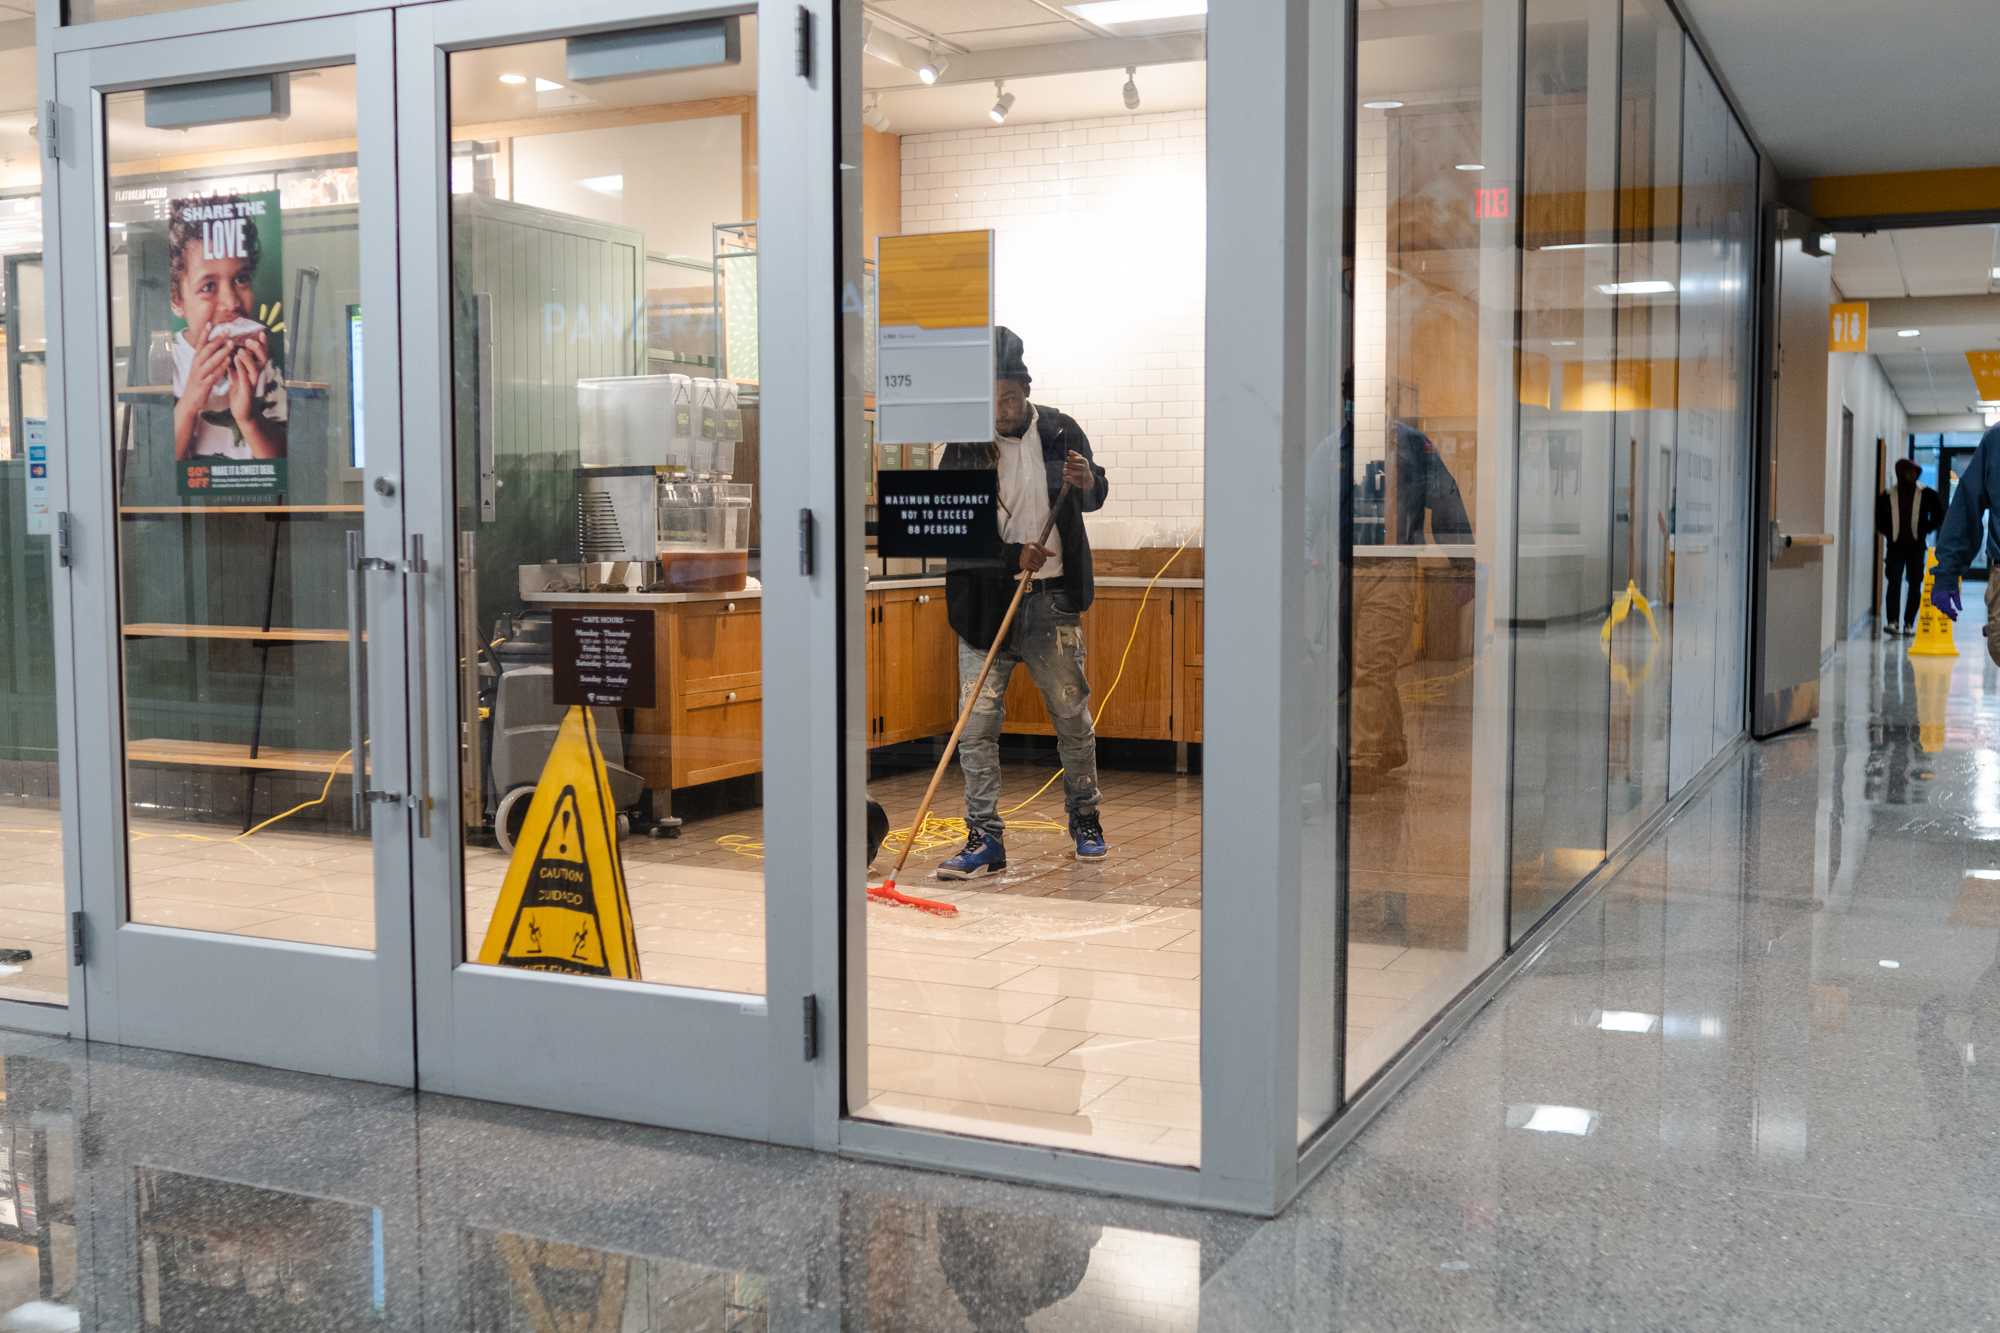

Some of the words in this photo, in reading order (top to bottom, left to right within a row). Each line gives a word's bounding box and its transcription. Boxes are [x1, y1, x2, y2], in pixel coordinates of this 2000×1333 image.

[183, 204, 232, 222] SHARE
[236, 201, 266, 217] THE
[202, 218, 248, 260] LOVE
[885, 374, 912, 388] 1375
[885, 495, 930, 505] MAXIMUM
[934, 495, 990, 504] OCCUPANCY
[901, 510, 917, 520] NOT
[922, 510, 934, 520] TO
[937, 510, 974, 519] EXCEED
[924, 525, 968, 535] PERSONS
[600, 616, 625, 624] HOURS
[575, 629, 599, 638] Monday
[603, 629, 632, 639] Thursday
[540, 867, 584, 882] CAUTION
